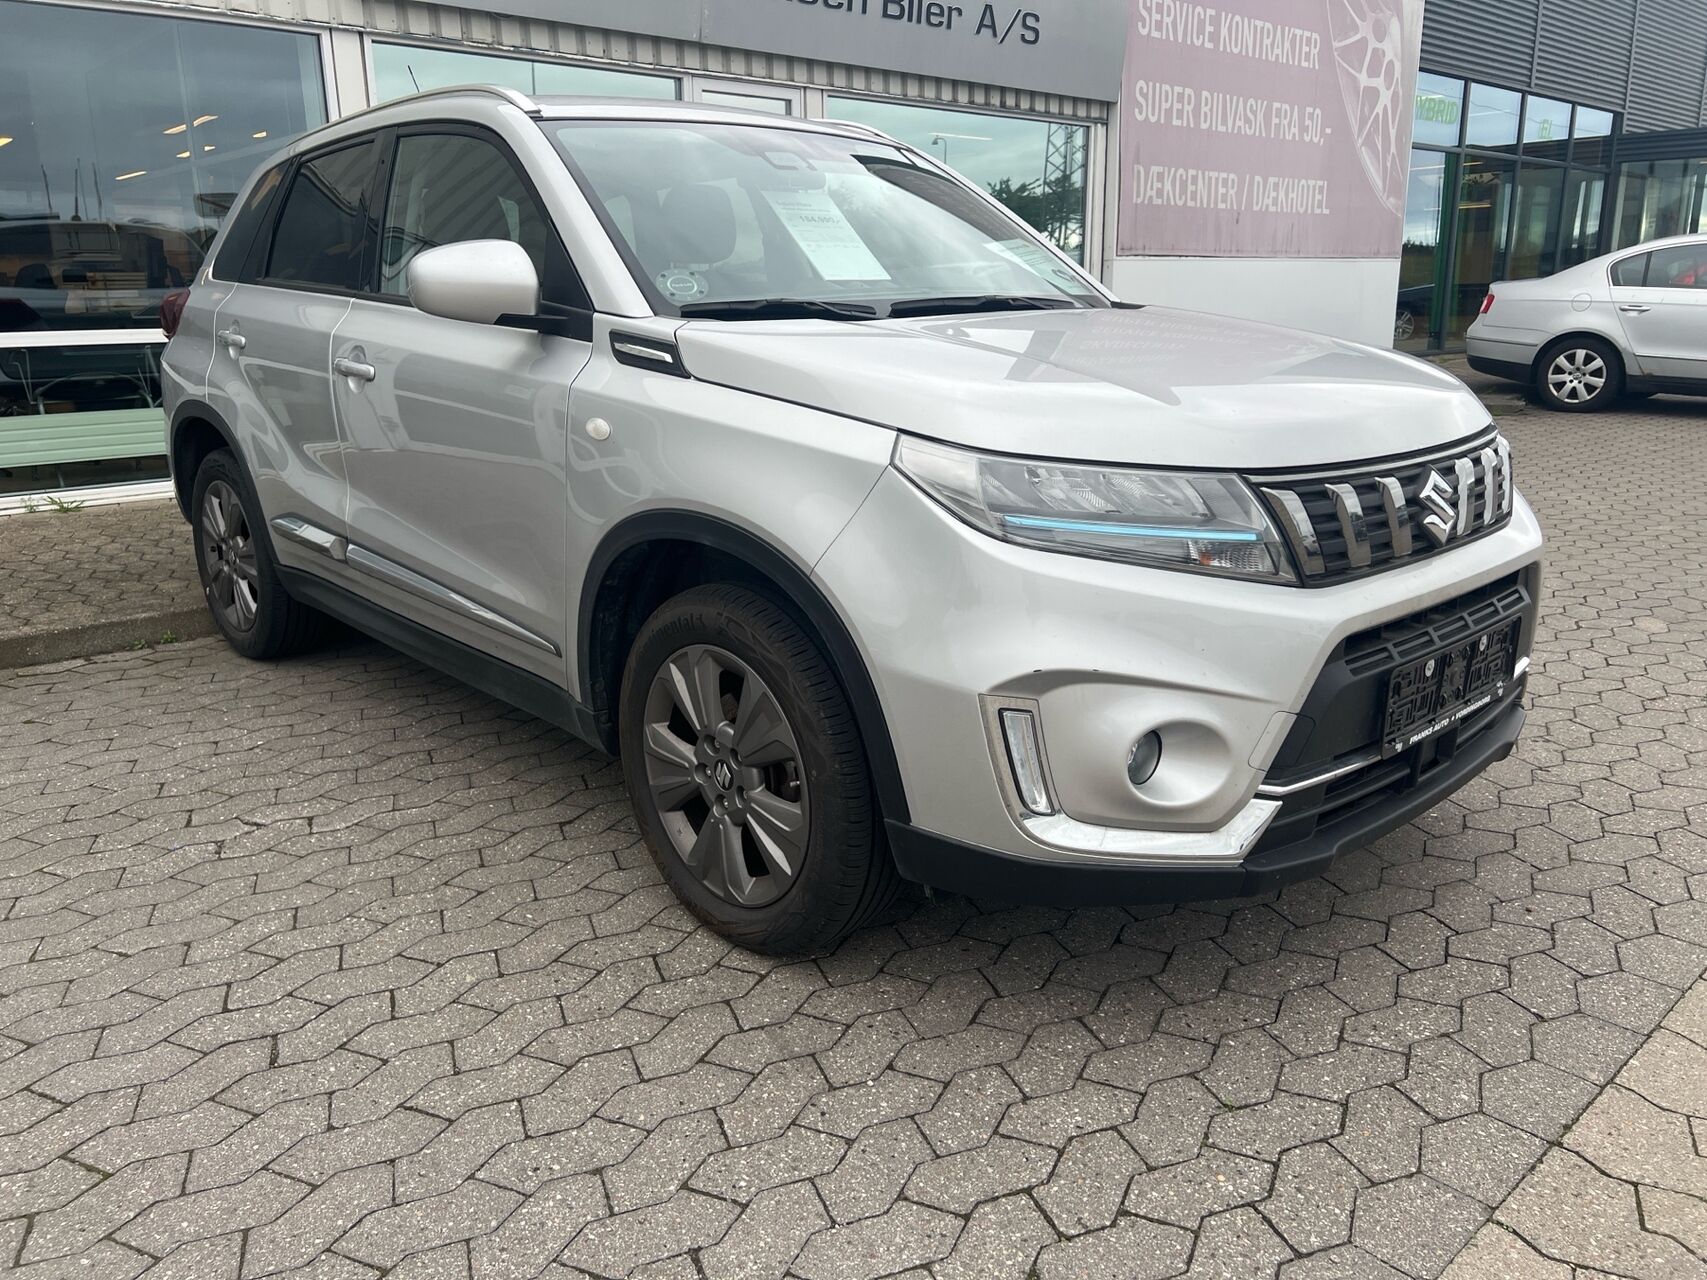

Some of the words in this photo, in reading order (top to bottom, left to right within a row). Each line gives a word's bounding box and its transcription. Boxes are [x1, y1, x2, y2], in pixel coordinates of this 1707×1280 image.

[975, 4, 1040, 45] A/S
[1137, 0, 1216, 49] SERVICE
[1219, 11, 1321, 69] KONTRAKTER
[1135, 80, 1195, 128] SUPER
[1200, 90, 1268, 137] BILVASK
[1271, 102, 1299, 141] FRA
[1303, 106, 1332, 146] 50,-
[1133, 164, 1238, 210] DÆKCENTER
[1241, 174, 1250, 210] /
[1252, 175, 1330, 215] DÆKHOTEL
[1432, 717, 1450, 732] AUTO
